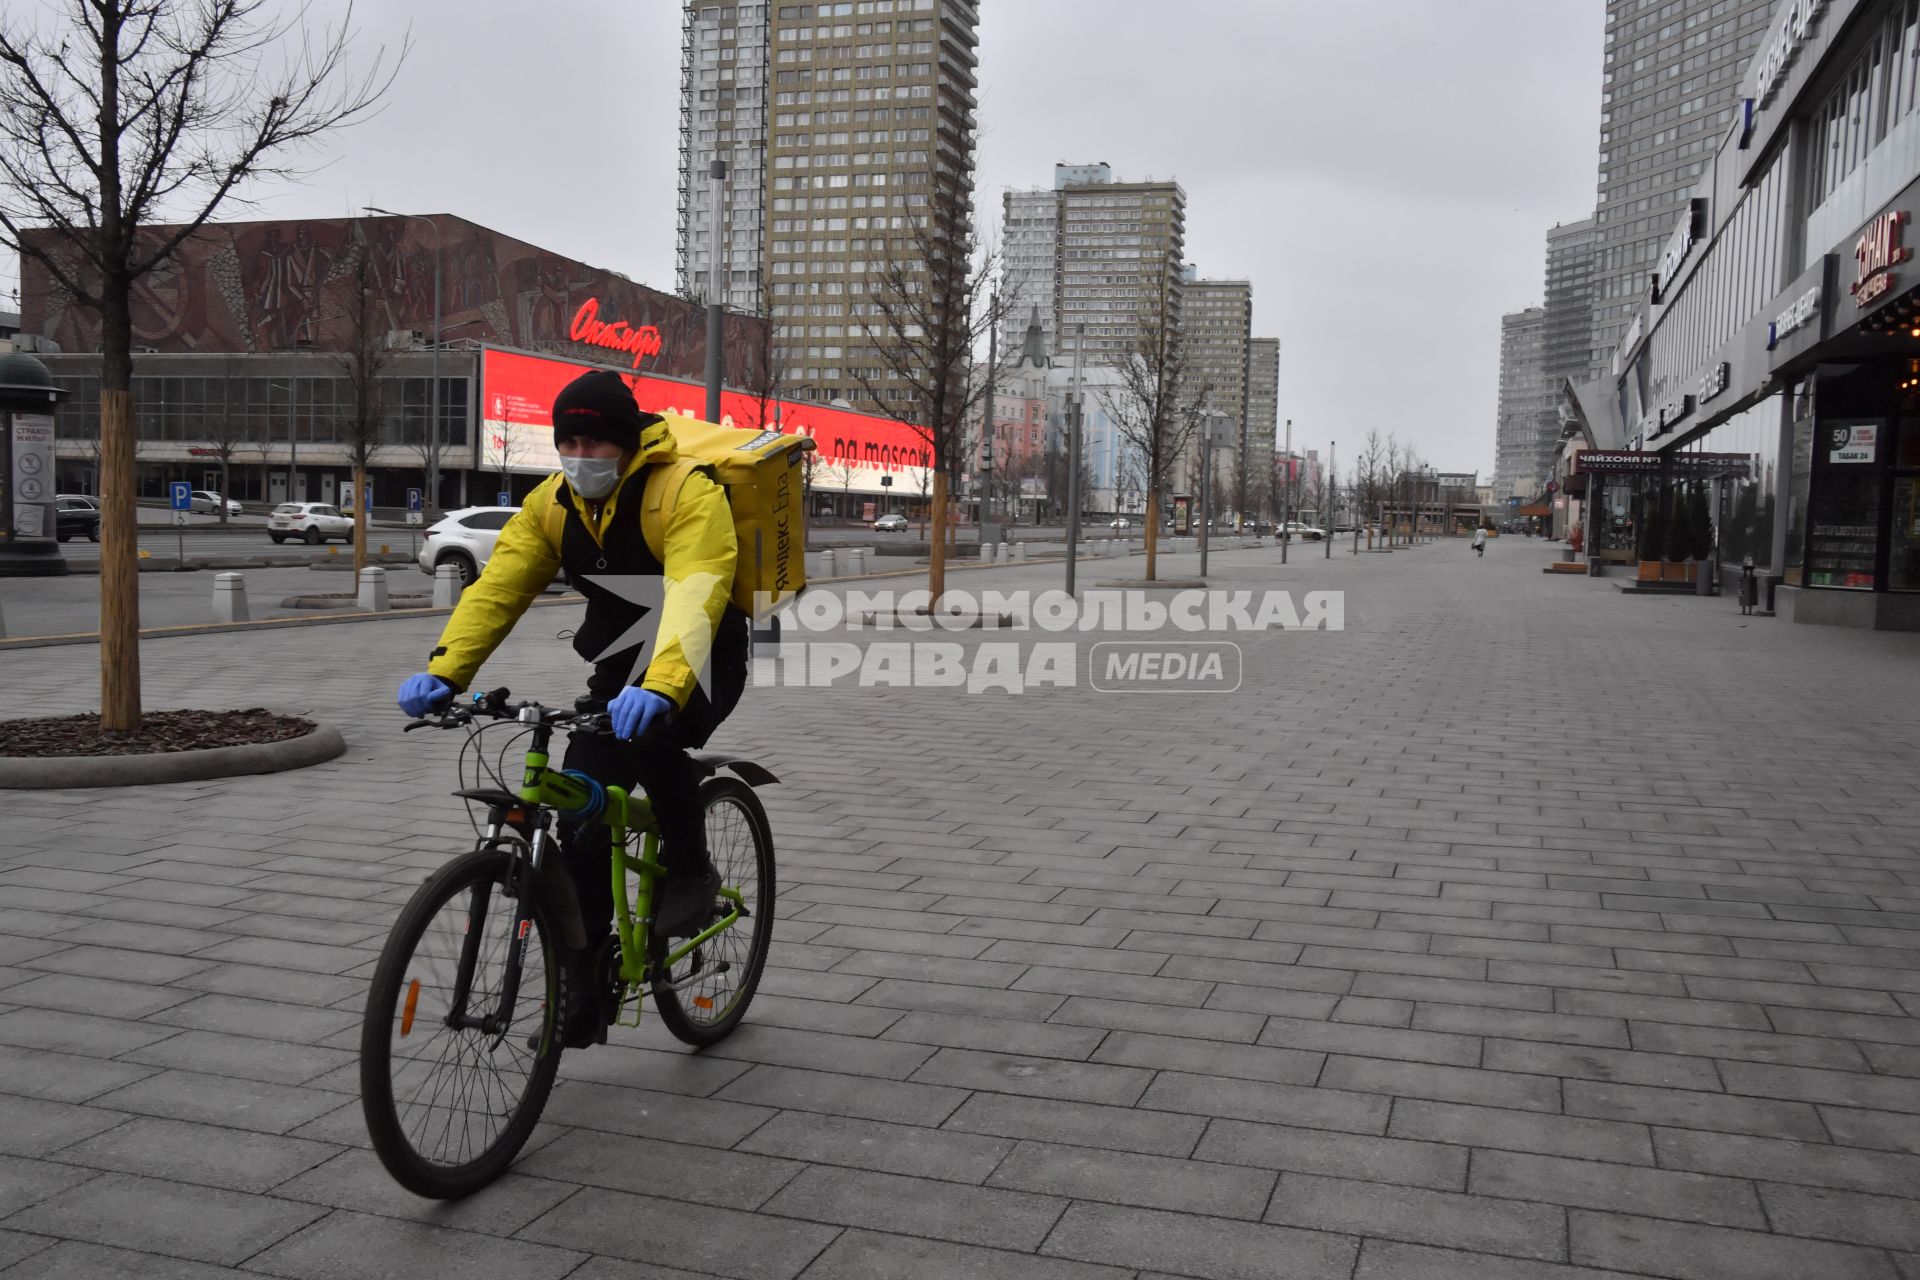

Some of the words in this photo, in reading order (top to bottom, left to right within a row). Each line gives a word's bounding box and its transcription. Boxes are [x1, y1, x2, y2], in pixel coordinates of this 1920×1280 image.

[571, 297, 662, 369] Октябрь
[1833, 429, 1847, 441] 50
[1579, 454, 1640, 463] ЧАЙХОНА
[176, 485, 187, 507] P
[410, 490, 418, 509] P
[771, 473, 791, 513] Еда
[775, 514, 791, 591] Яндекс
